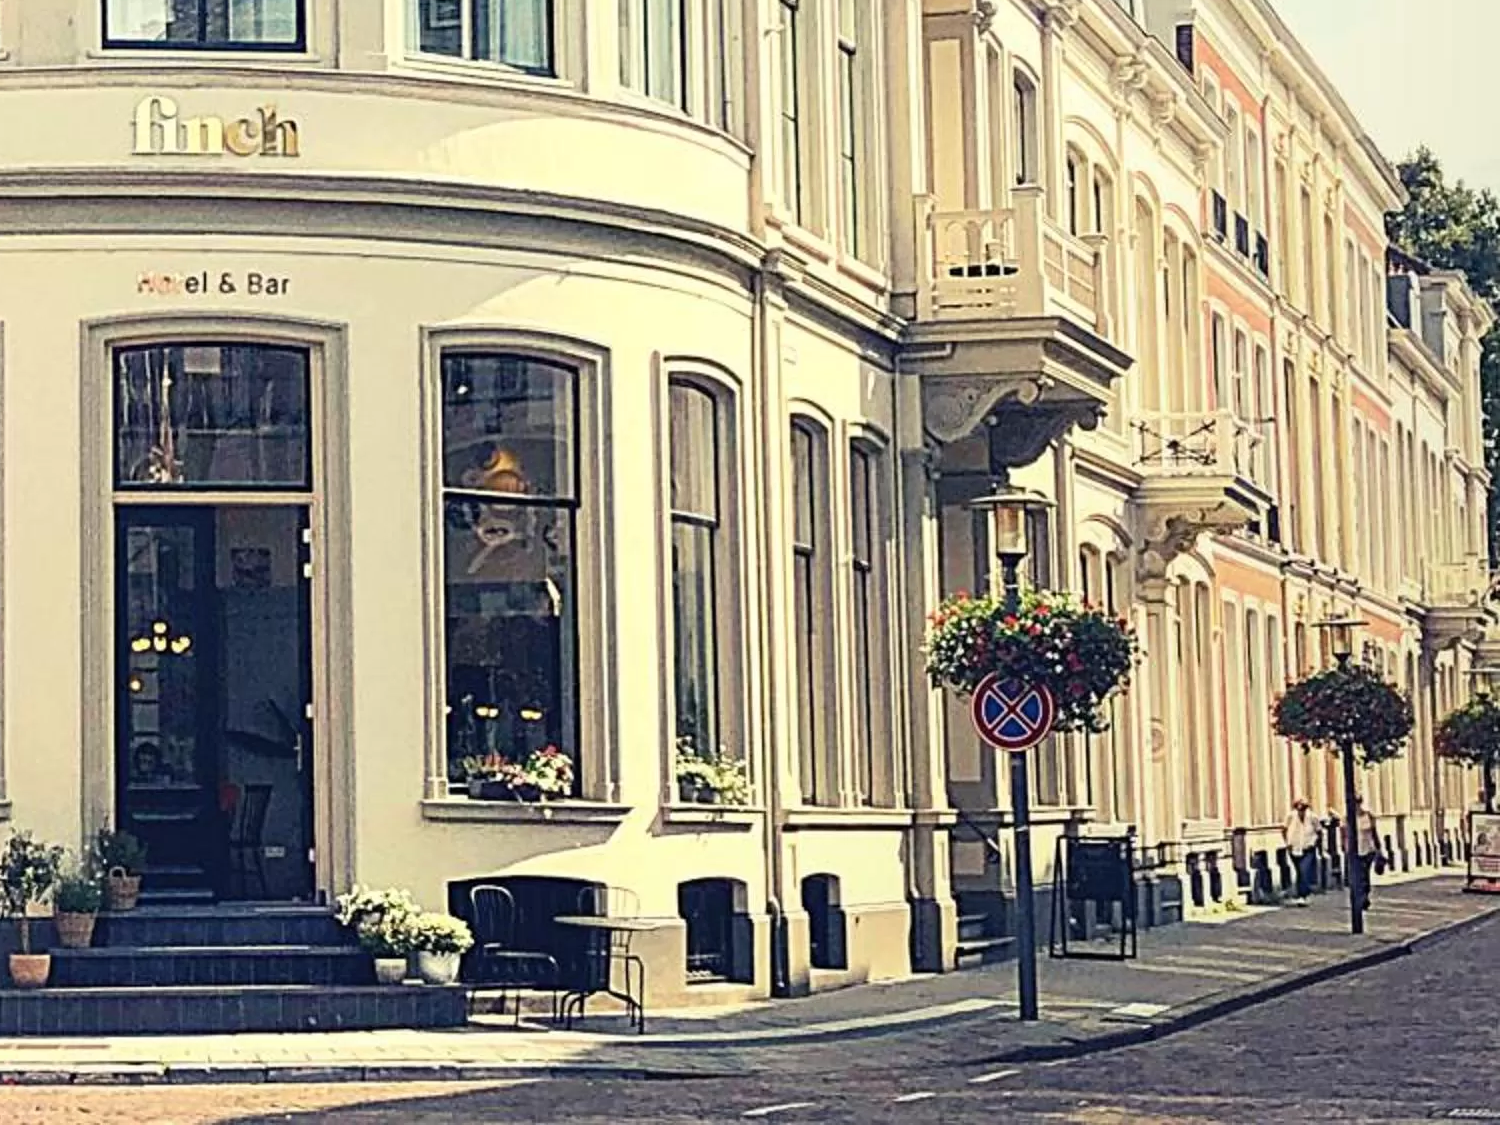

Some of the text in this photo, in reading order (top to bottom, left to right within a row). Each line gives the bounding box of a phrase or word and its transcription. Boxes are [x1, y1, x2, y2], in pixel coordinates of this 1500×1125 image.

[129, 95, 301, 158] finch
[219, 272, 236, 294] &
[247, 272, 290, 295] Bar
